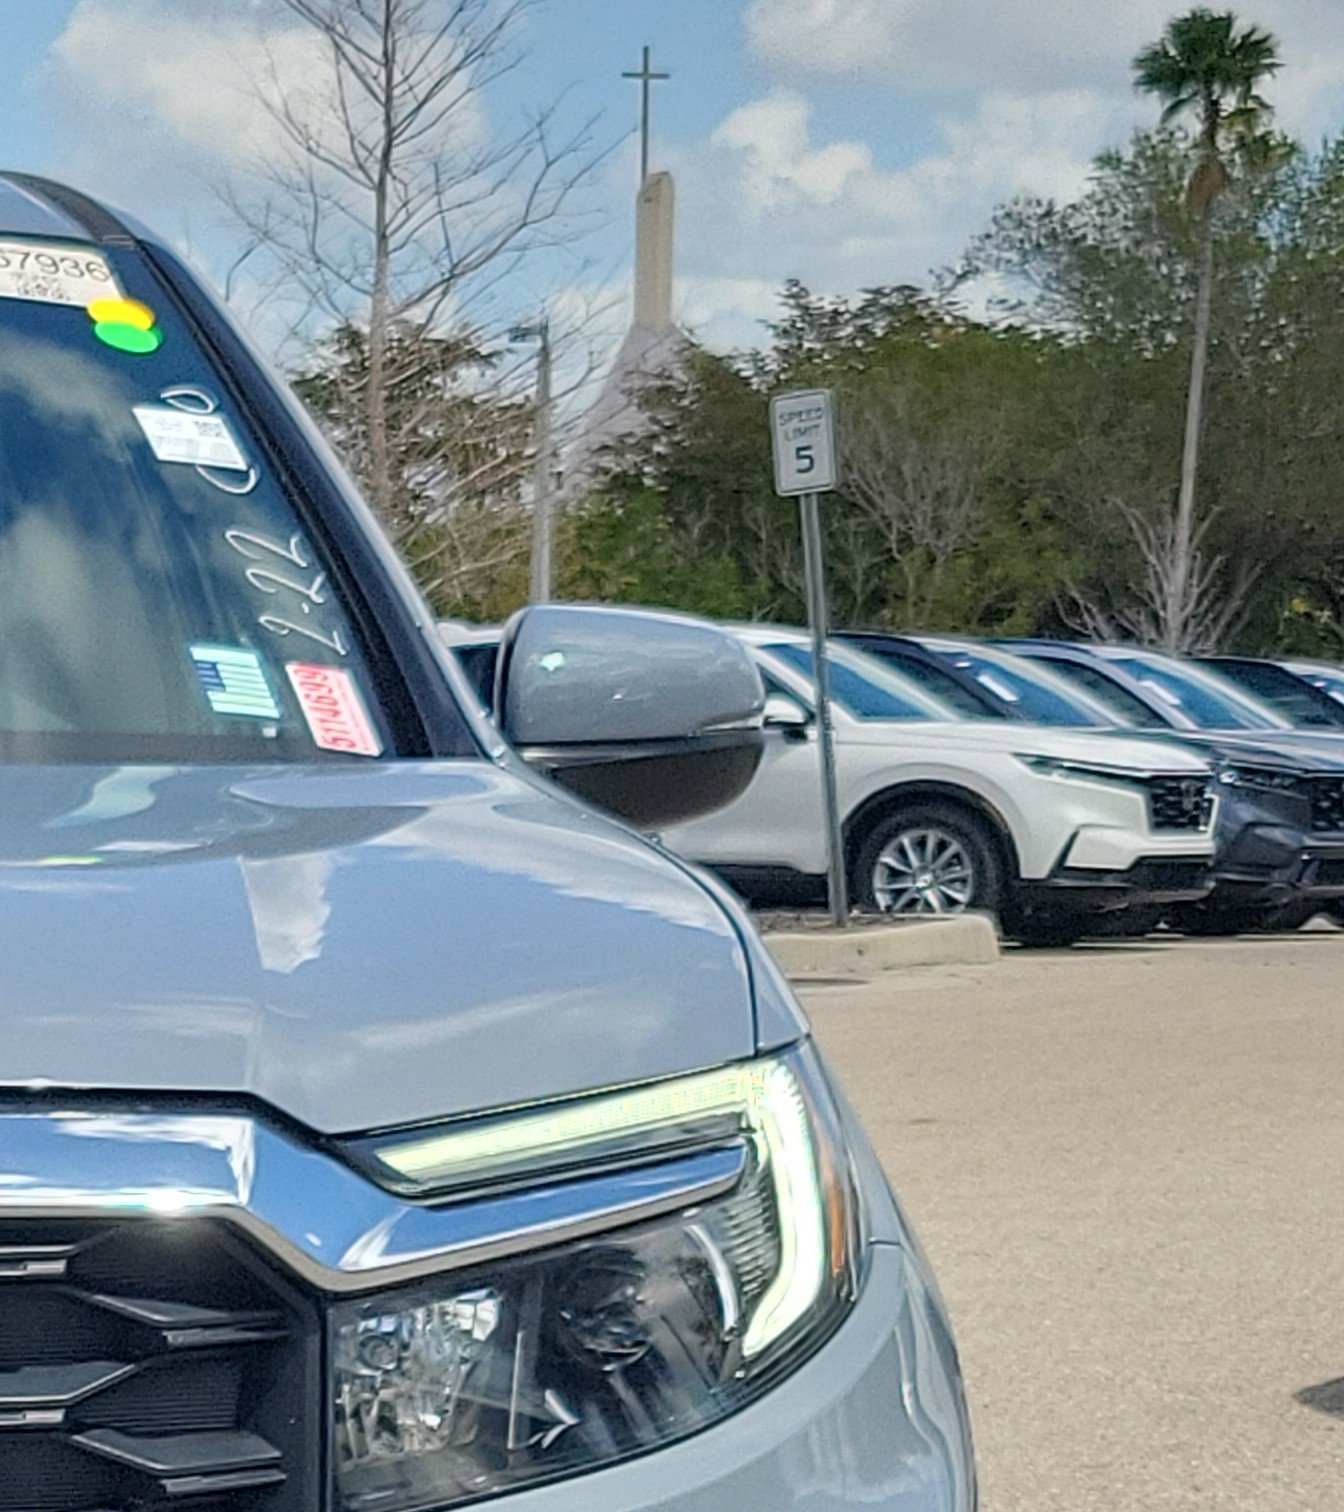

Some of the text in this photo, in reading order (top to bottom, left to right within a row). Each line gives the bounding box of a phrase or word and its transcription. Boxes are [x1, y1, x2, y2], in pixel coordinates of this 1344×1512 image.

[779, 406, 823, 427] SPEED
[783, 423, 821, 442] LIMIT
[795, 444, 815, 474] 5
